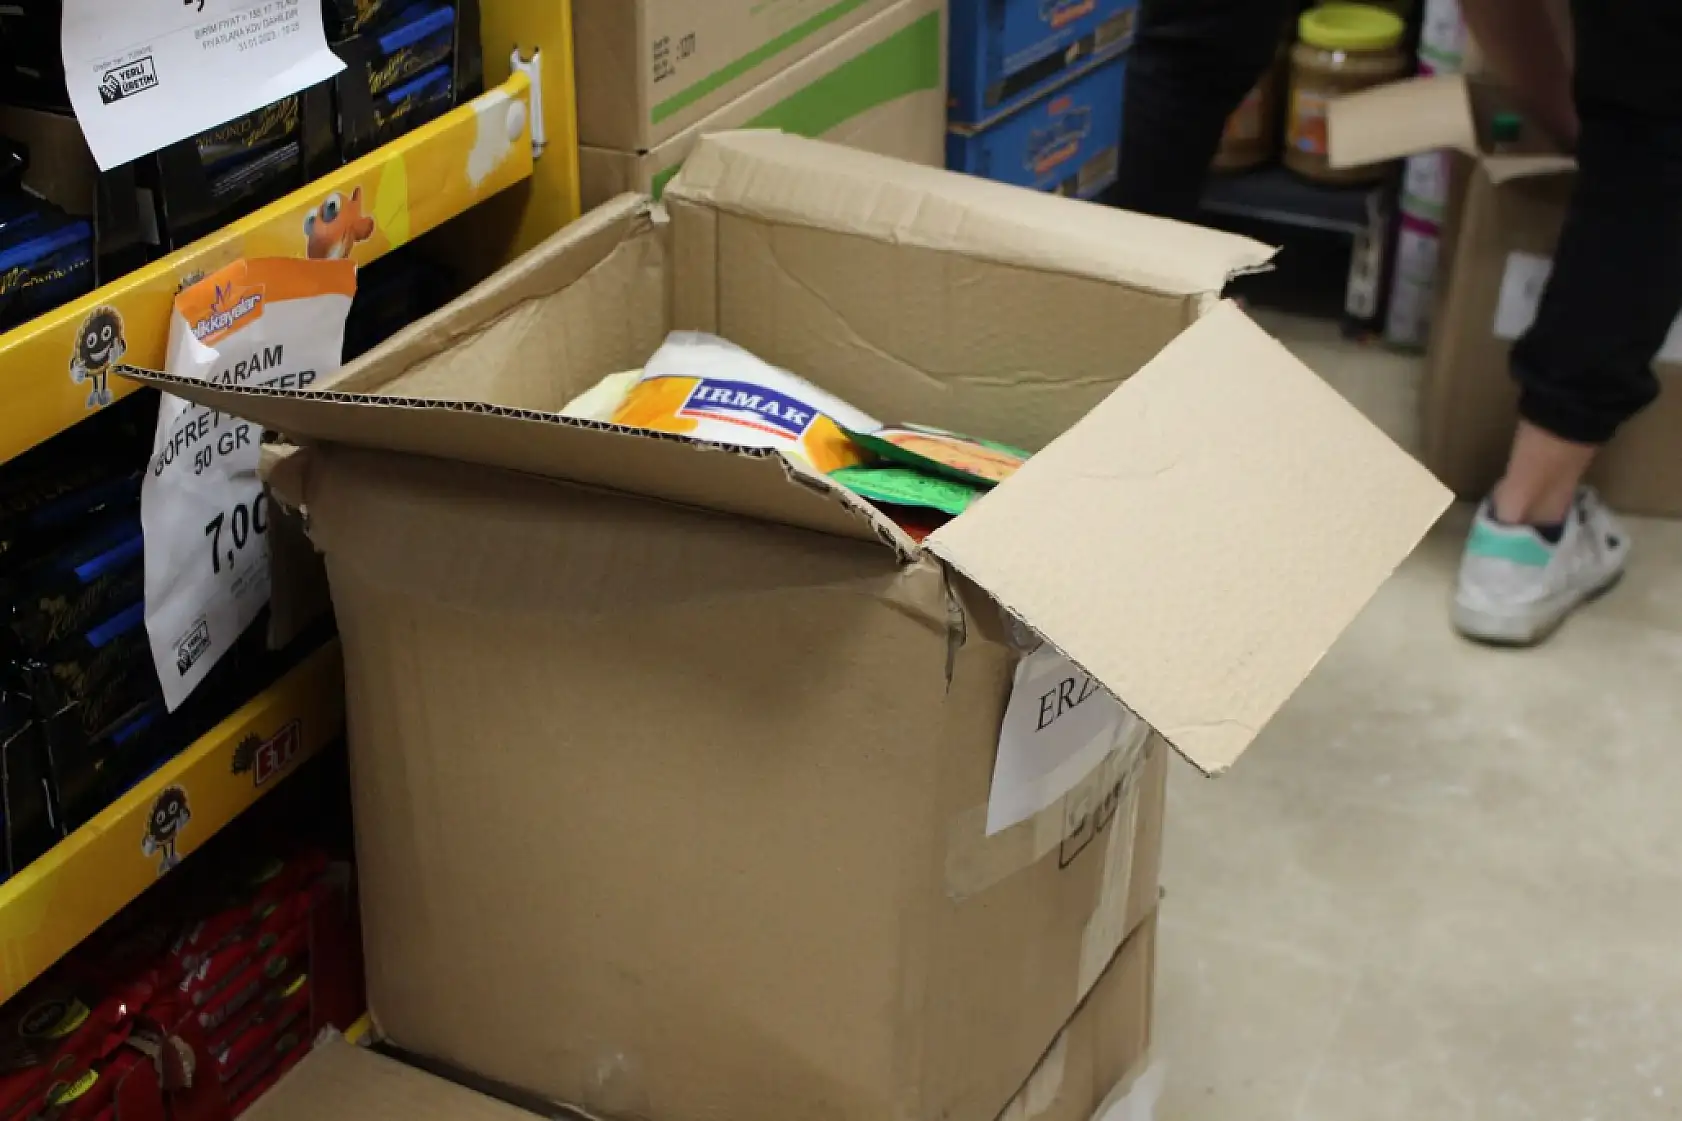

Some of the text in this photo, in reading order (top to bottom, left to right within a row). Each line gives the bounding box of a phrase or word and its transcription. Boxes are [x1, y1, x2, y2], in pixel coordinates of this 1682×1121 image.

[694, 385, 810, 426] IRMAK
[194, 423, 251, 476] 50 GR
